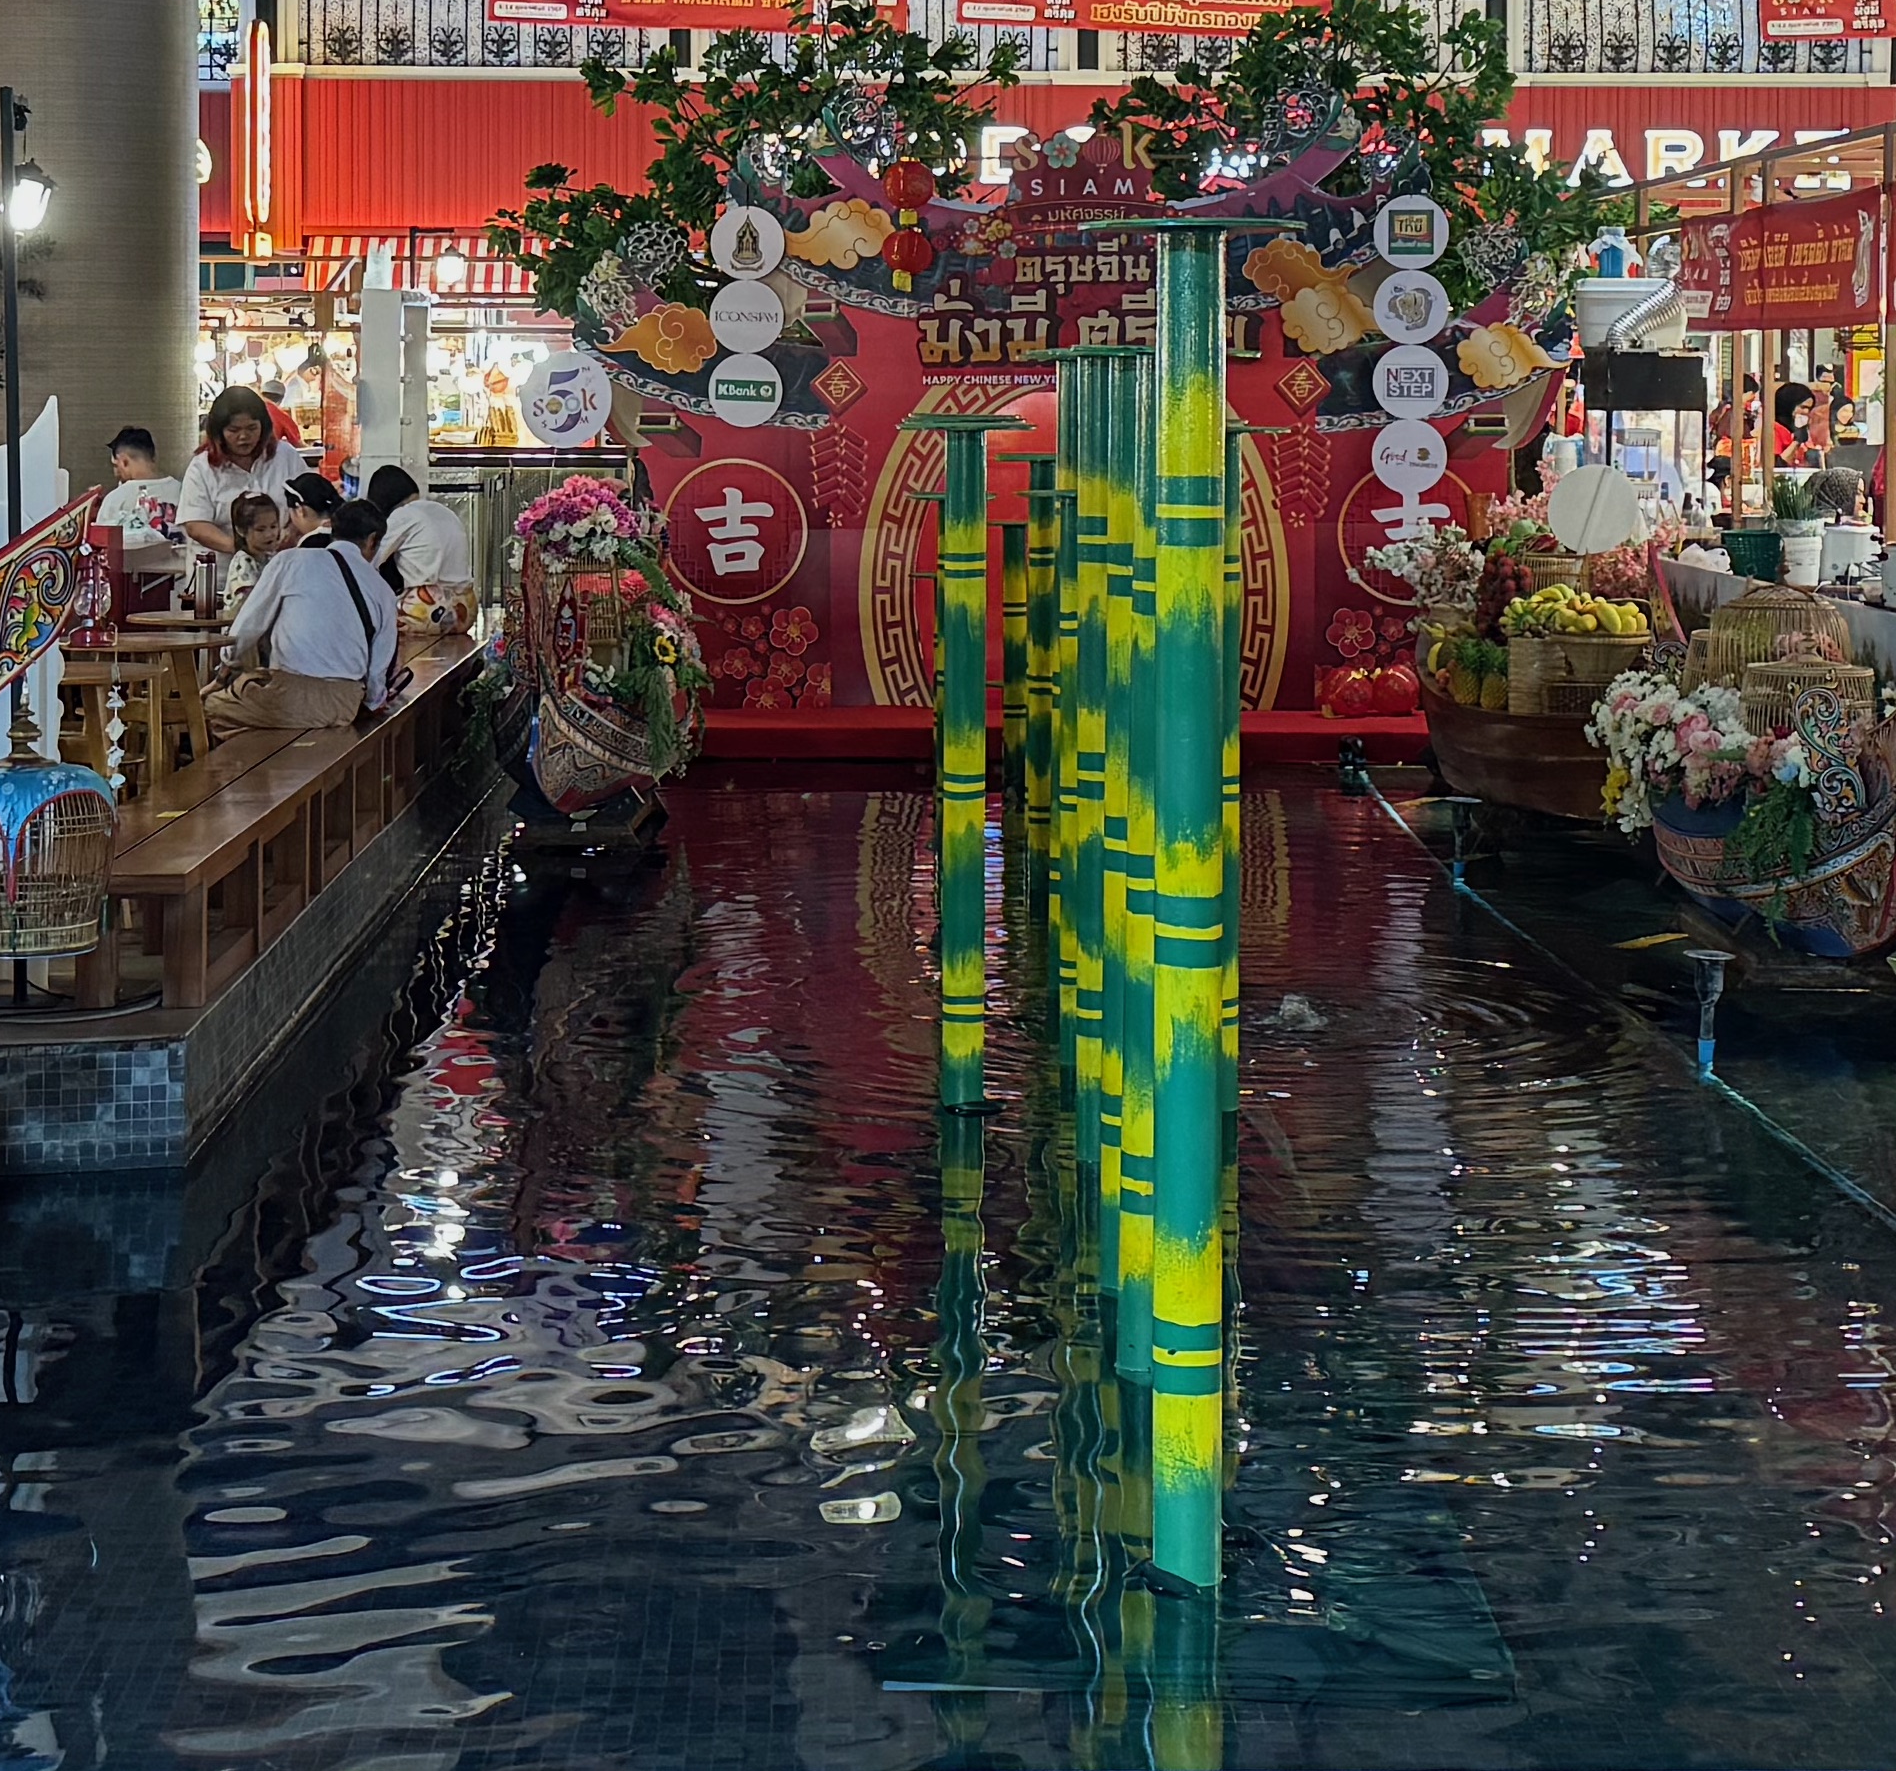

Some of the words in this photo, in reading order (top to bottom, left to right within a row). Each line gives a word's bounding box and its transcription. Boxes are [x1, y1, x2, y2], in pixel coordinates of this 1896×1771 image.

[1779, 7, 1826, 16] SIAM
[1030, 178, 1135, 196] SIAM
[1015, 237, 1151, 294] ตรุษจีน
[714, 310, 779, 324] ICONSIAM
[918, 279, 1052, 364] มั่งมี
[826, 369, 851, 398] 春
[922, 375, 960, 386] HAPPY
[963, 375, 1012, 386] CHINESE
[1014, 374, 1041, 385] NEW
[1288, 369, 1315, 398] 春
[1386, 368, 1433, 383] NEXT
[717, 383, 757, 397] KBank
[1387, 383, 1433, 397] STEP
[693, 486, 775, 576] 吉
